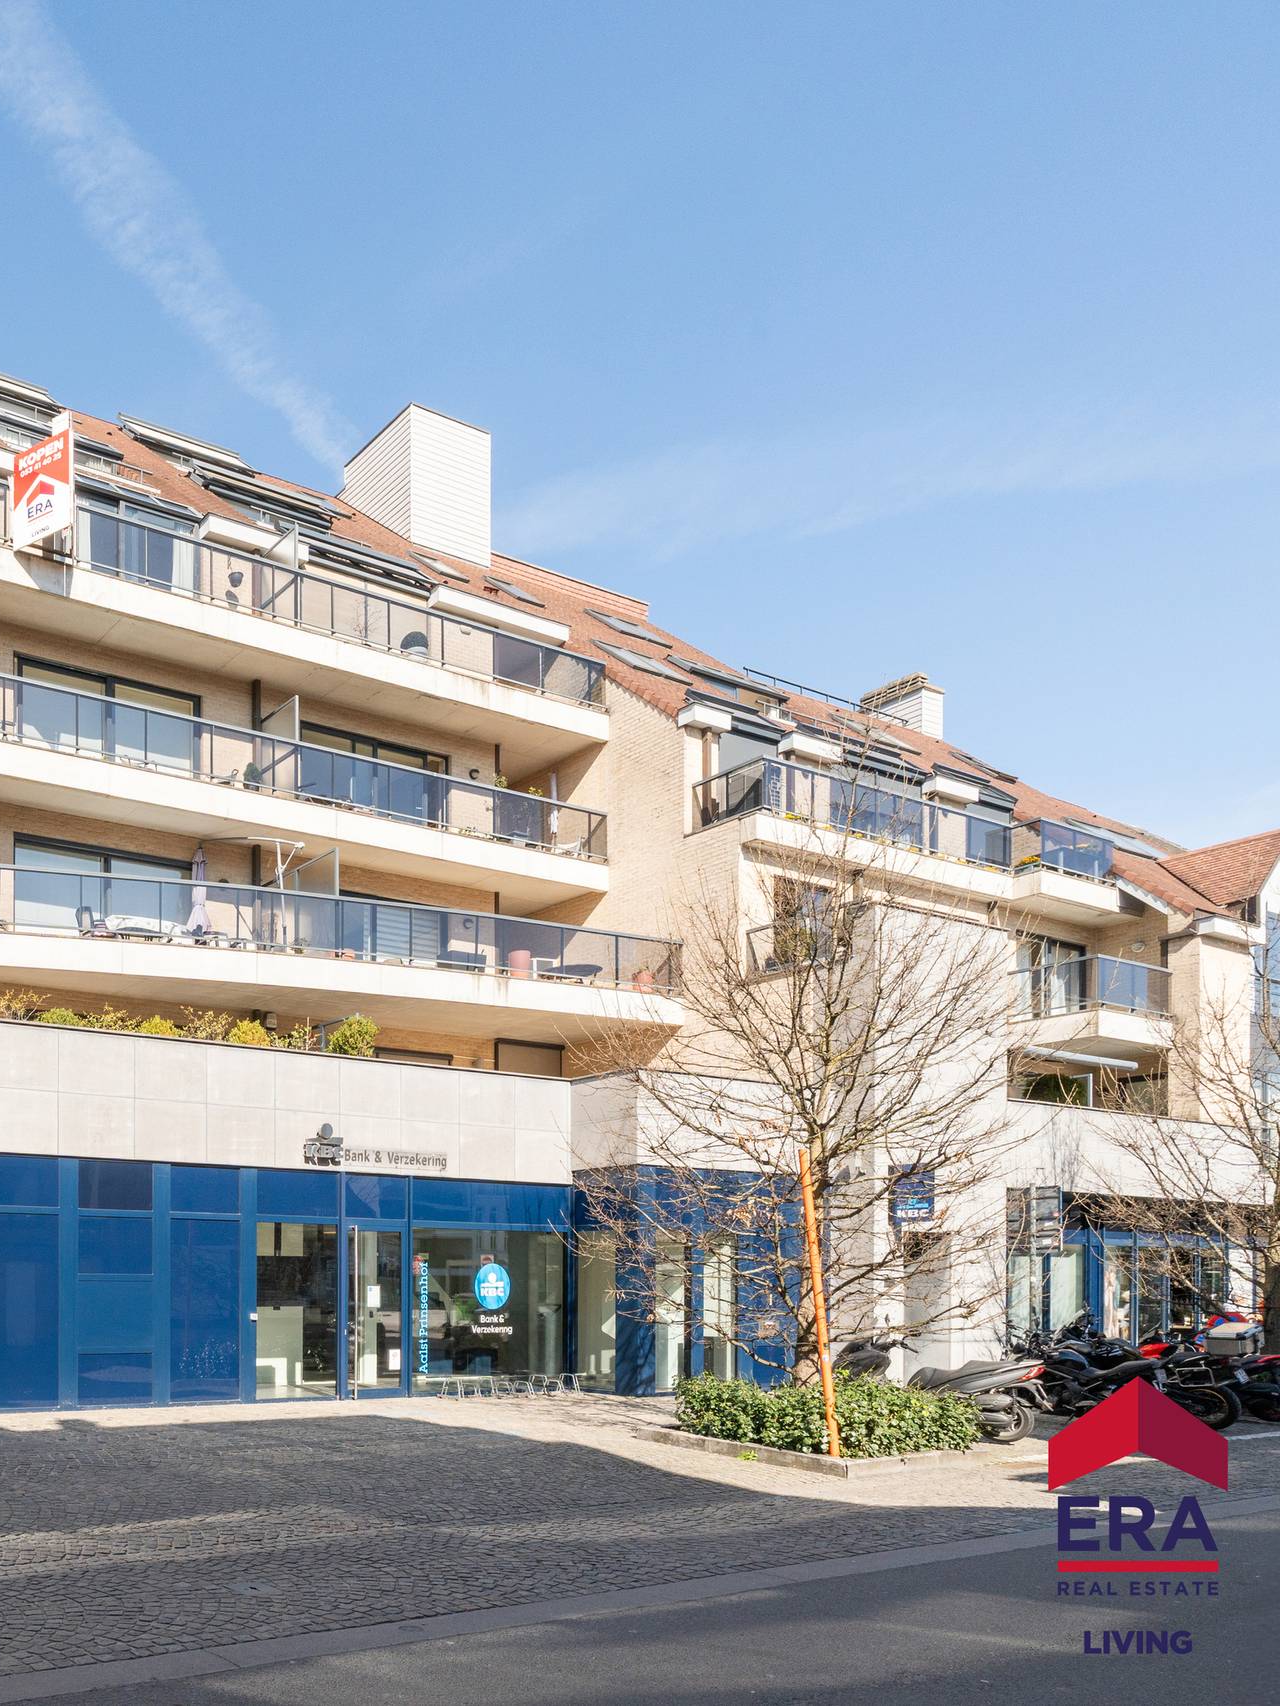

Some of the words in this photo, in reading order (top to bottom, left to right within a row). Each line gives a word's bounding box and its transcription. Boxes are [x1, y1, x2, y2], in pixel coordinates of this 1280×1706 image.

[19, 437, 64, 471] KOPEN
[27, 499, 53, 518] ERA
[31, 525, 50, 537] LIVING
[305, 1144, 344, 1161] KBC
[344, 1149, 370, 1163] Bank
[374, 1151, 382, 1163] &
[387, 1152, 448, 1170] Verzekering
[896, 1208, 931, 1219] KBC
[419, 1261, 429, 1336] Prinsenhof
[480, 1287, 505, 1297] KBC
[480, 1314, 498, 1323] Bank
[498, 1314, 505, 1323] &
[471, 1325, 513, 1335] Verzekering
[419, 1340, 429, 1374] Aalst
